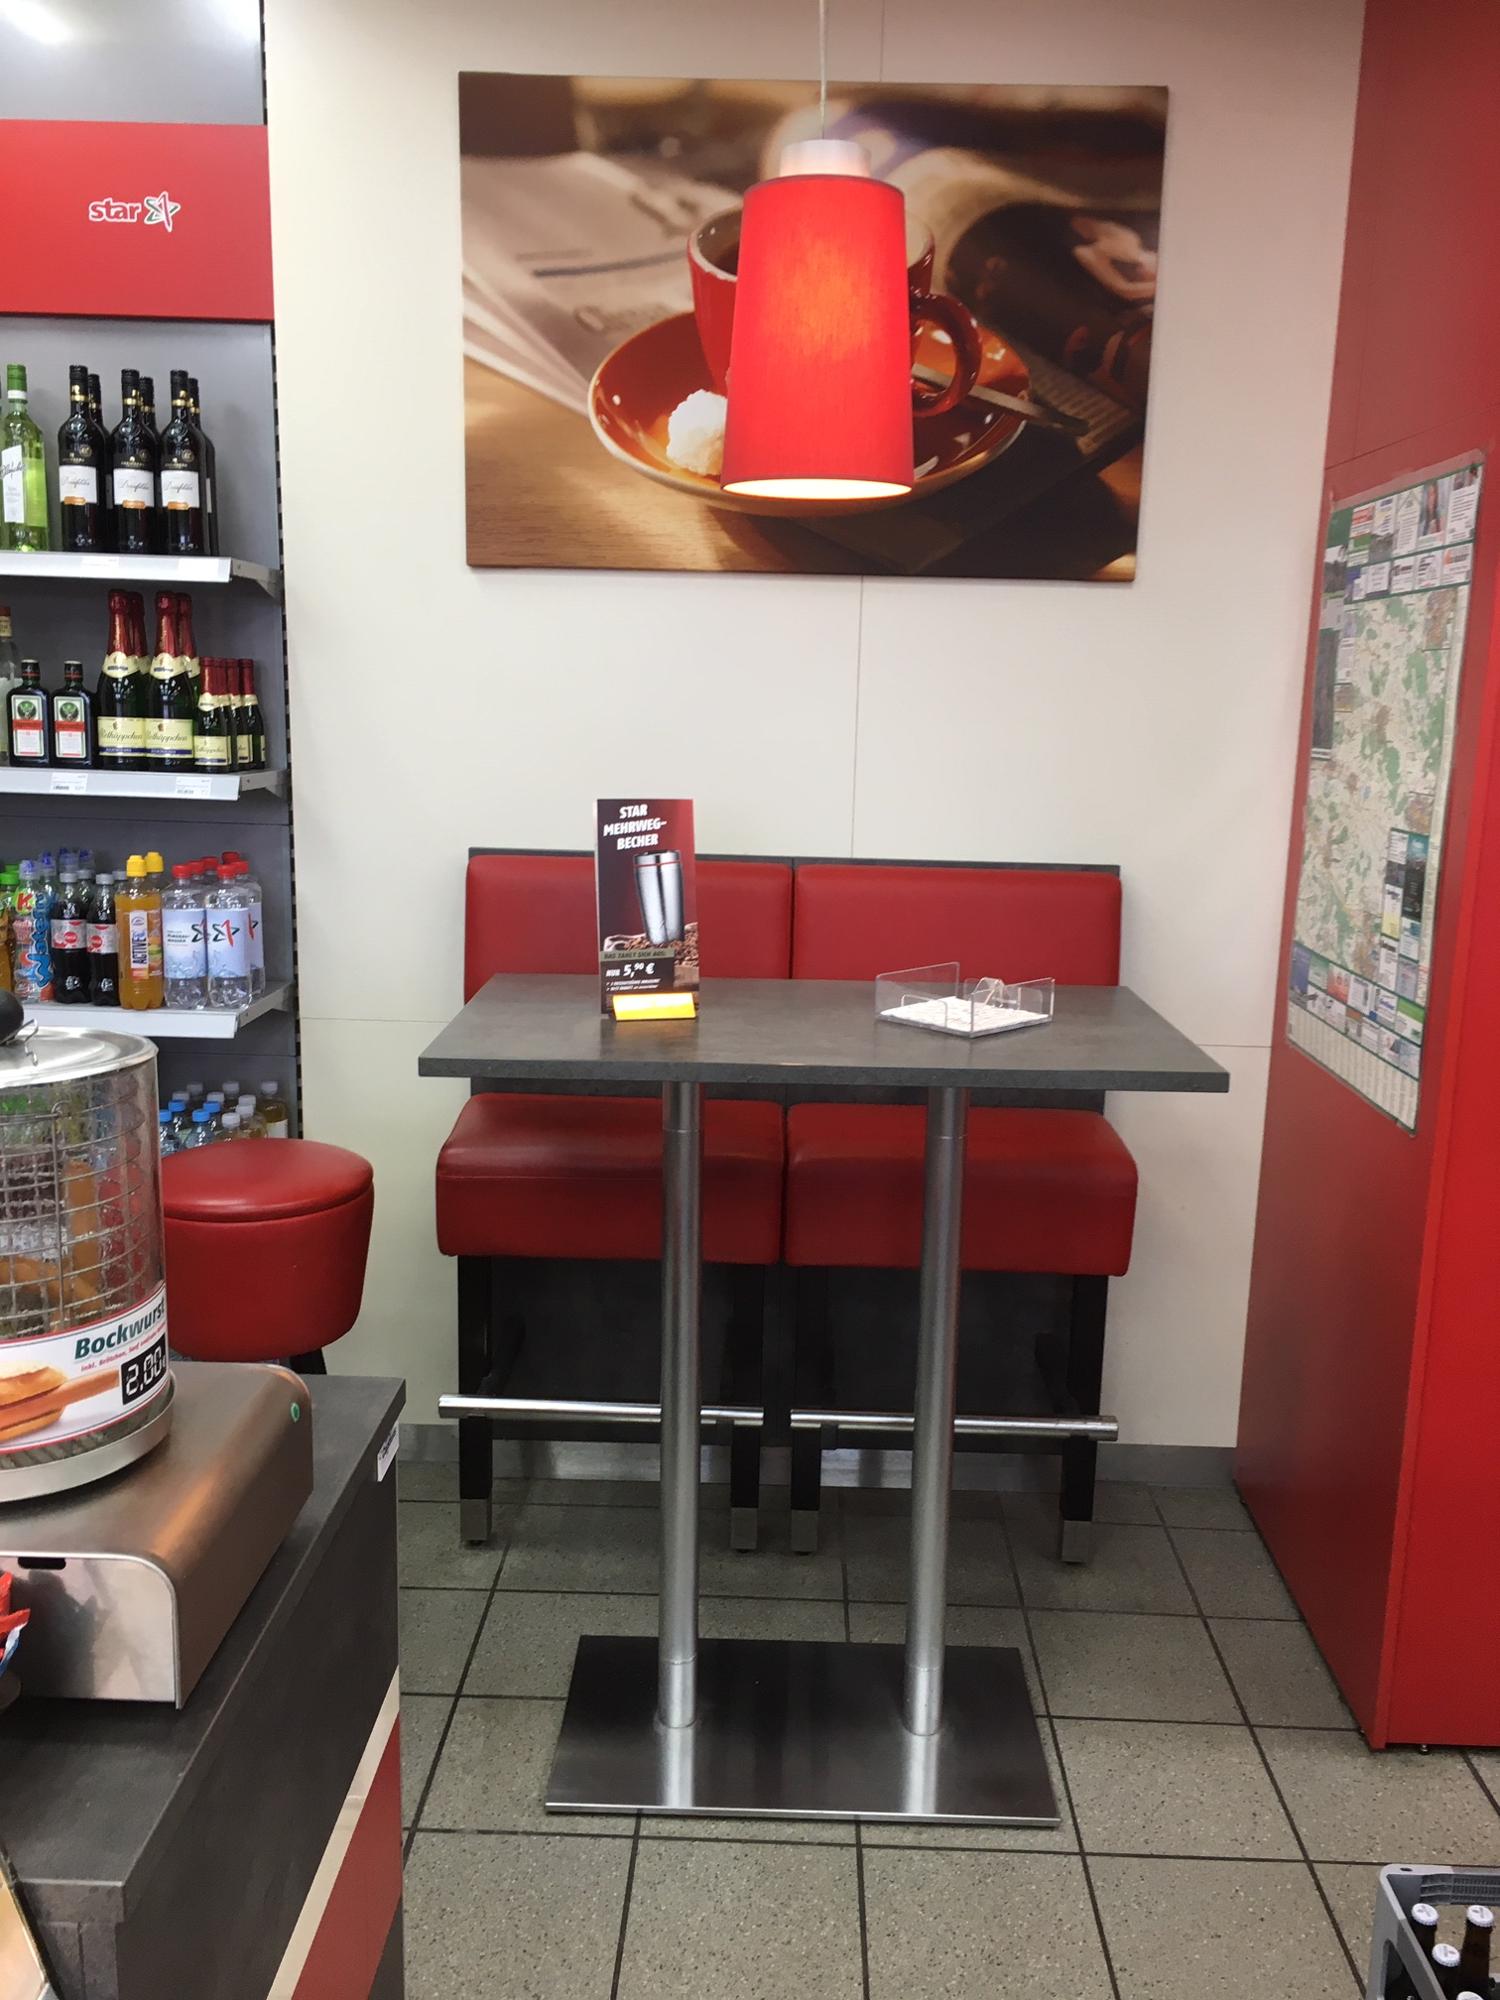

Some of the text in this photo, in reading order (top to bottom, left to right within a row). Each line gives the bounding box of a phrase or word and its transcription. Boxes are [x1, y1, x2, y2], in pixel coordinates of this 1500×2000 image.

[89, 198, 141, 222] star
[619, 803, 648, 819] STAR
[603, 817, 667, 836] MEHRWEG-
[616, 833, 659, 850] BECHER
[645, 962, 655, 975] €
[75, 1297, 165, 1359] Bockwurst
